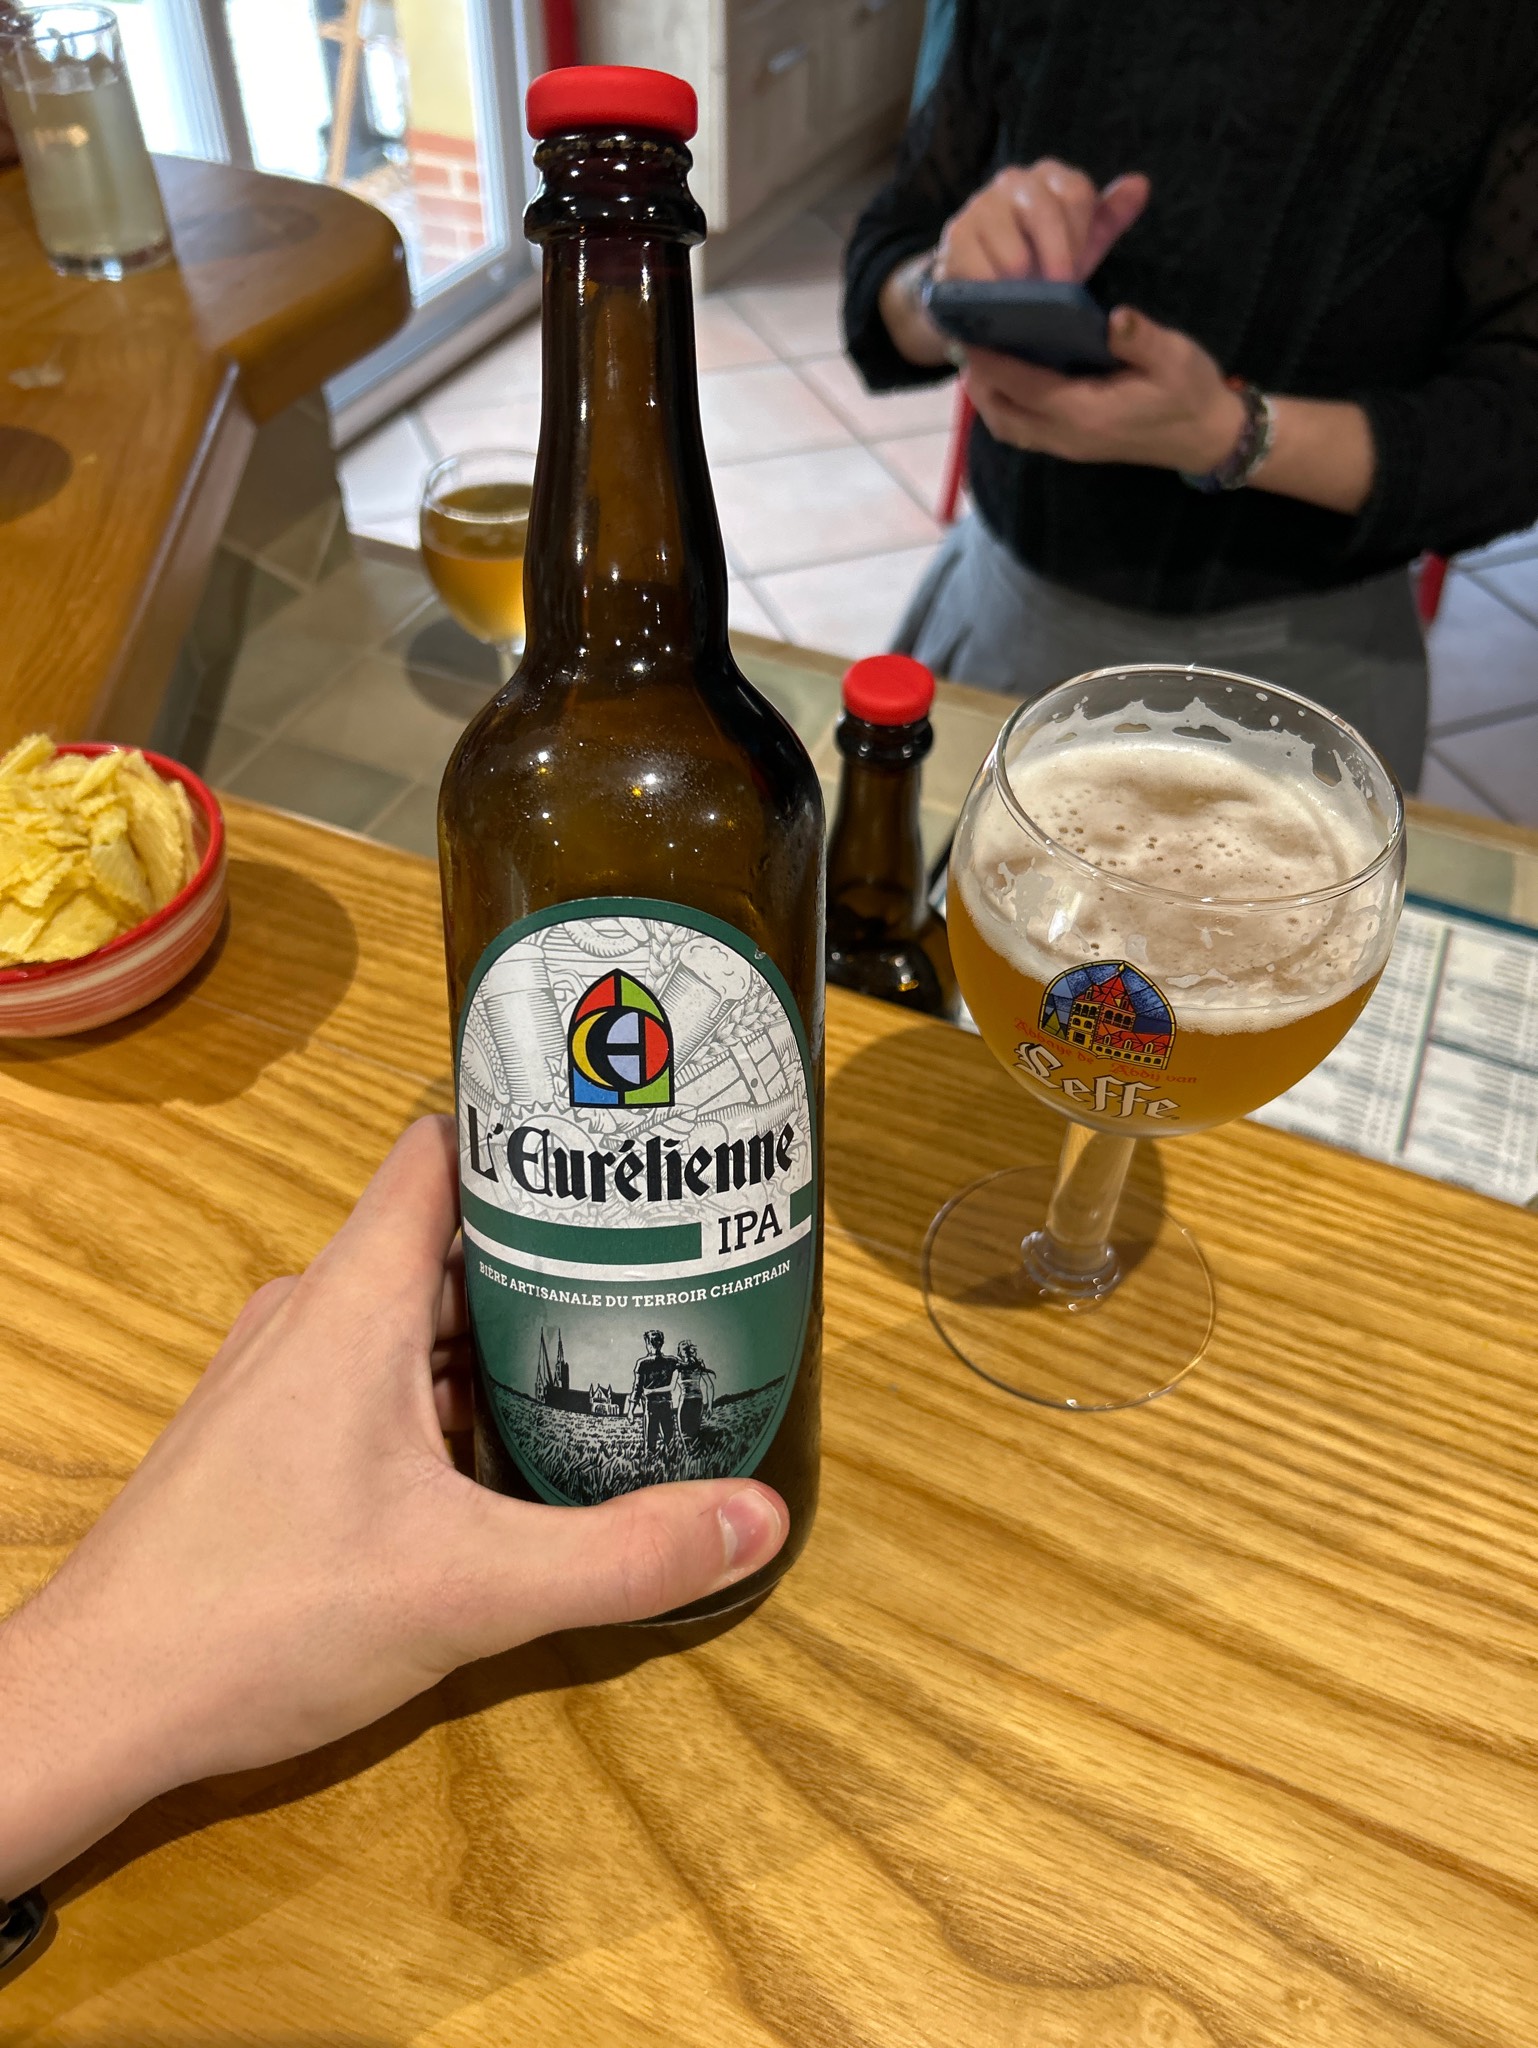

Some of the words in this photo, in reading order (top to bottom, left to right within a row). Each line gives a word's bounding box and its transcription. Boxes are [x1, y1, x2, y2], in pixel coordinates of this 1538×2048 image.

[1013, 1042, 1181, 1119] Leffe
[1077, 1051, 1094, 1064] de
[1166, 1075, 1198, 1084] van
[467, 1103, 795, 1203] L'Eurélienne
[717, 1203, 783, 1255] IPA
[479, 1260, 508, 1287] BIÈRE
[509, 1278, 602, 1307] ARTISANALE
[605, 1295, 628, 1308] DU
[632, 1288, 707, 1308] TERROIR
[710, 1260, 791, 1298] CHARTRAIN
